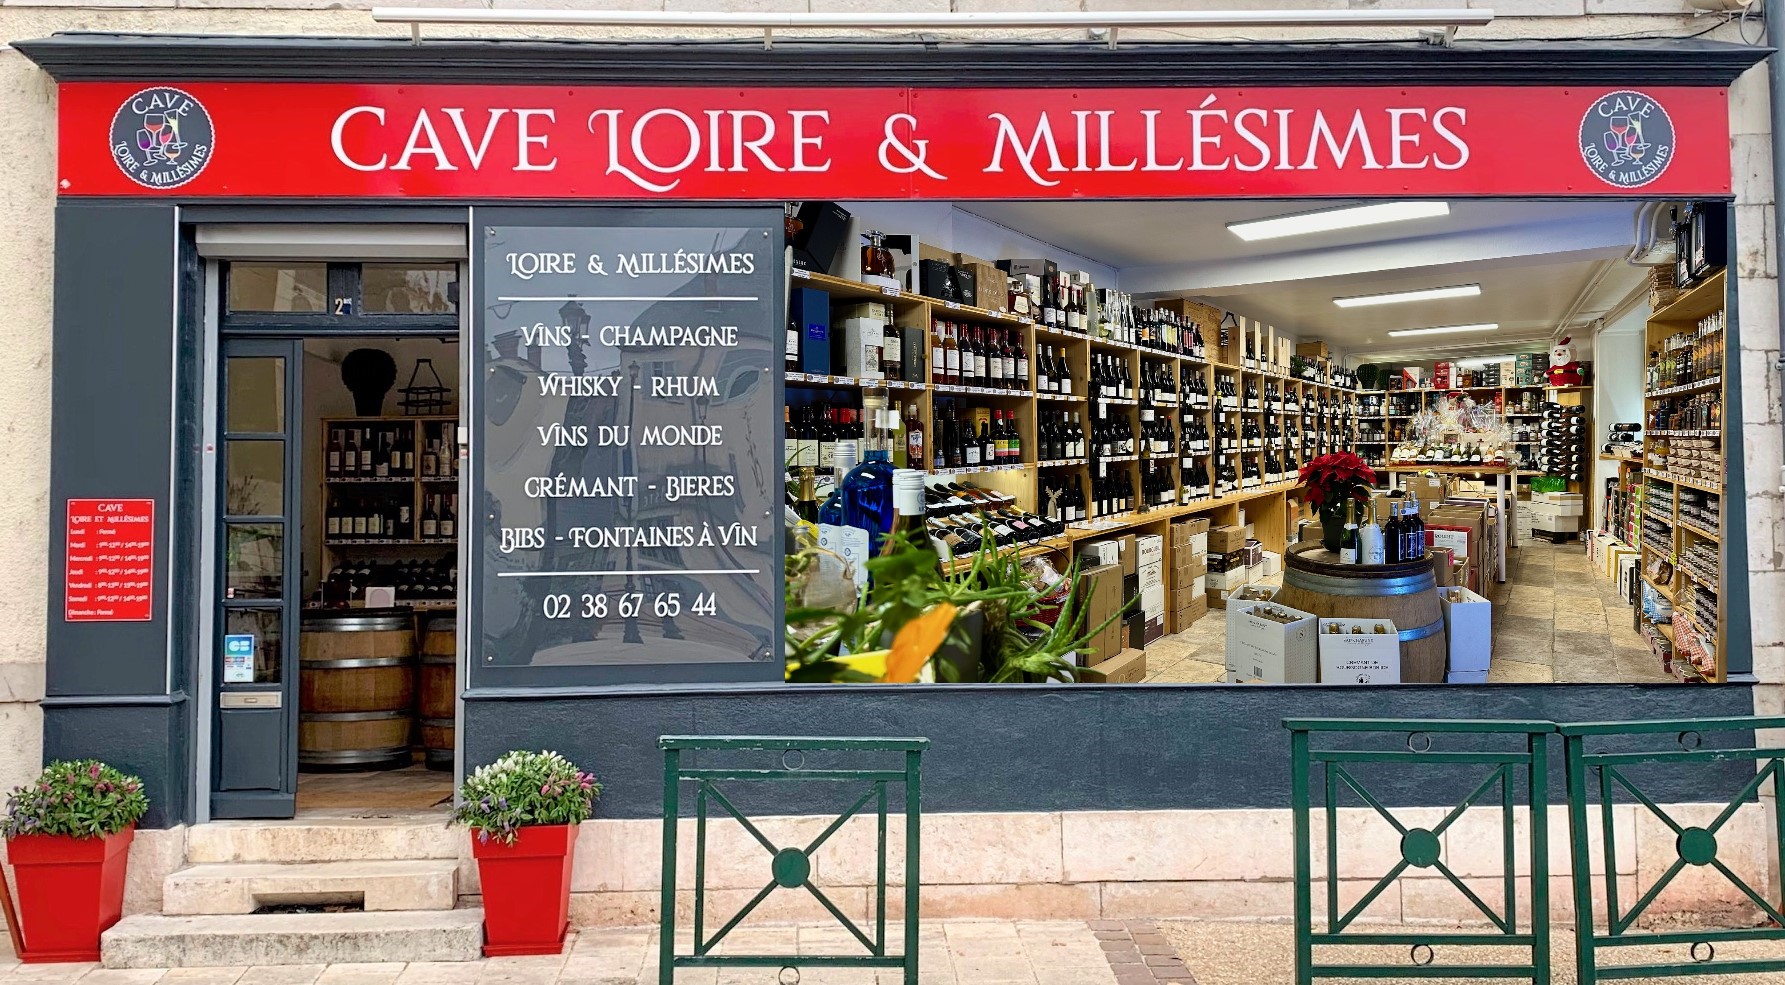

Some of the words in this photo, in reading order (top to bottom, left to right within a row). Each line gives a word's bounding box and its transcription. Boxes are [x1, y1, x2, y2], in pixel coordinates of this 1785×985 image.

[132, 92, 194, 117] CAVE
[1598, 96, 1655, 118] CAVE
[331, 105, 558, 173] CAVE
[588, 108, 831, 193] LOIRE
[878, 113, 948, 180] &
[983, 93, 1470, 187] MILLÉSIMES
[114, 140, 140, 173] LOIRE
[140, 170, 148, 181] &
[150, 144, 207, 185] MILLÉSIMES
[1584, 143, 1609, 173] LOIRE
[1609, 170, 1616, 181] &
[1619, 144, 1669, 184] MILLÉSIMES
[505, 252, 577, 280] LOIRE
[587, 254, 609, 276] &
[616, 248, 755, 278] MILLÉSIMES
[521, 322, 572, 347] VINS
[599, 325, 739, 347] CHAMPAGNE
[538, 373, 624, 397] WHISKY
[651, 376, 720, 397] RHUM
[537, 423, 588, 447] VINS
[598, 425, 630, 447] DU
[640, 424, 723, 446] MONDE
[524, 472, 639, 498] CRÉMANT
[665, 475, 735, 502] BIERES
[70, 516, 92, 524] LOIRE
[107, 515, 150, 523] MILLÉSIMES
[98, 504, 124, 512] CAVE
[499, 527, 545, 554] BIBS
[569, 524, 694, 548] FONTAINES
[697, 523, 714, 547] À
[719, 522, 758, 547] VIN
[543, 594, 570, 619] 02
[581, 593, 608, 618] 38
[618, 593, 644, 618] 67
[654, 592, 681, 617] 65
[690, 592, 717, 616] 44
